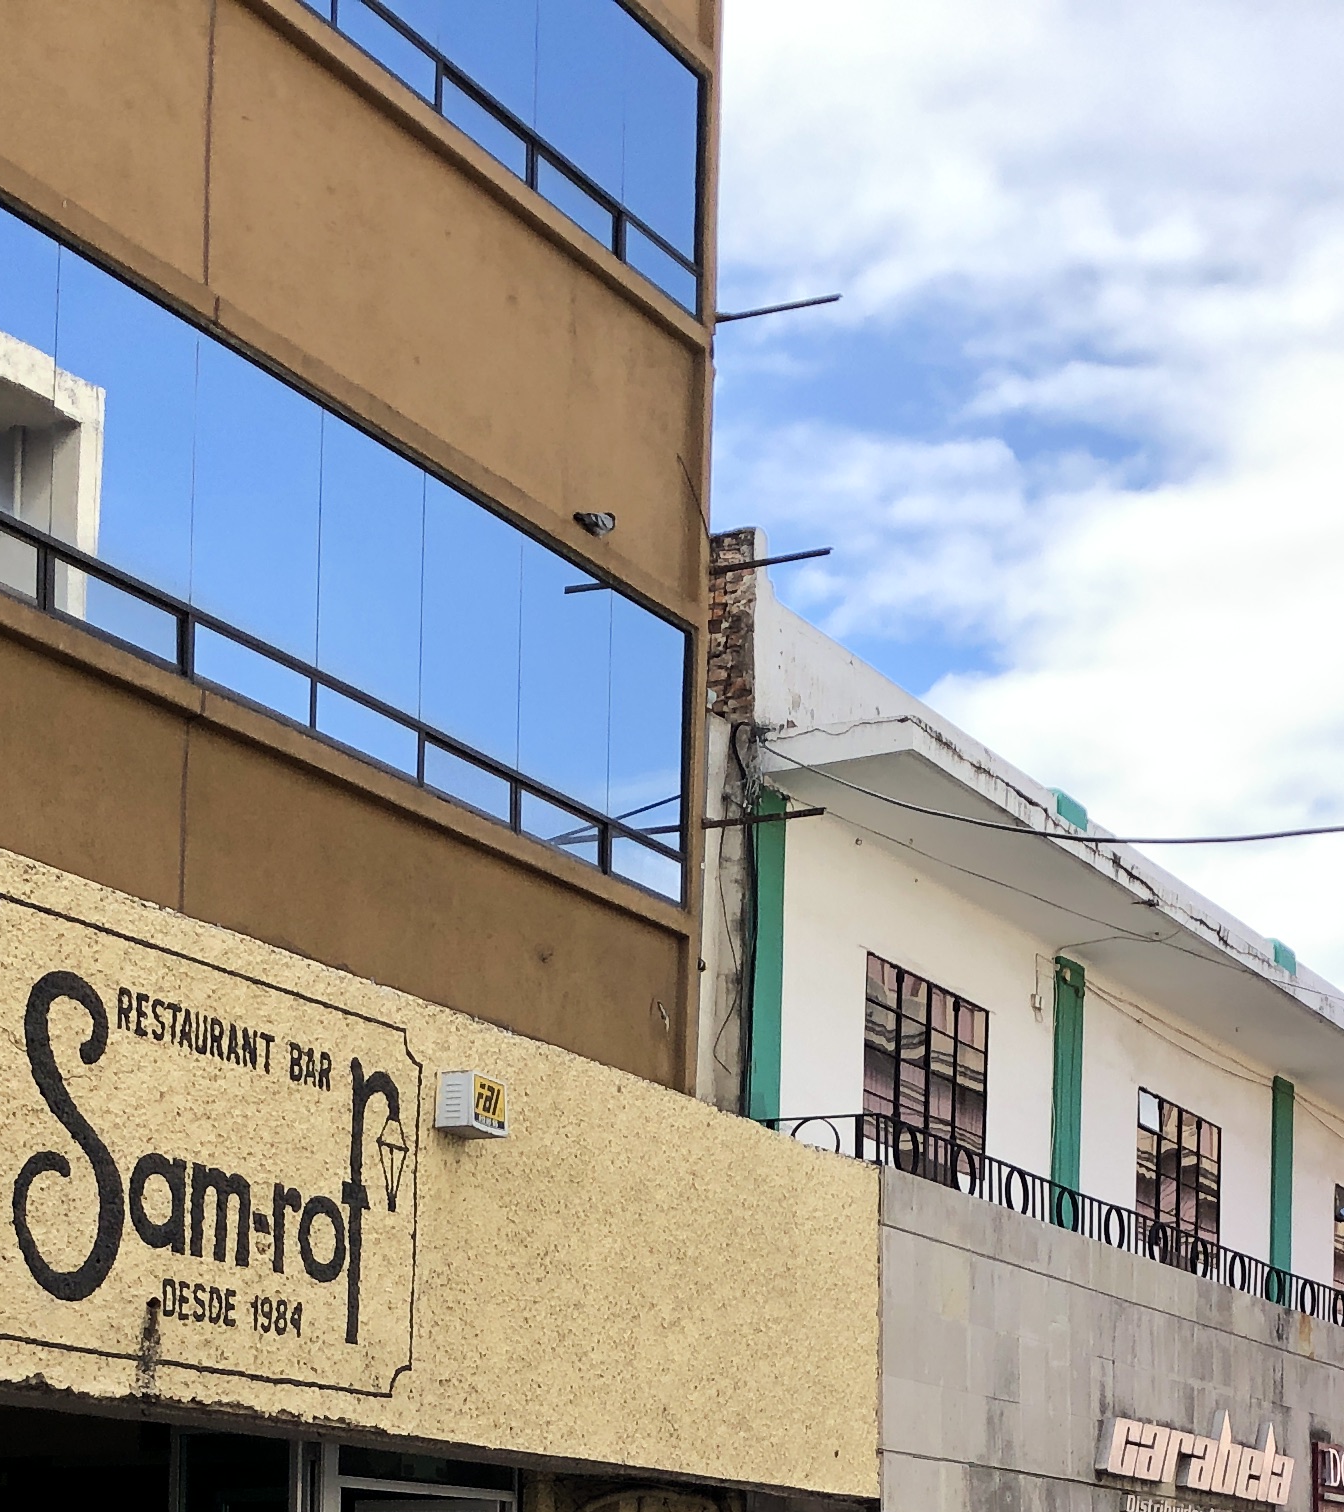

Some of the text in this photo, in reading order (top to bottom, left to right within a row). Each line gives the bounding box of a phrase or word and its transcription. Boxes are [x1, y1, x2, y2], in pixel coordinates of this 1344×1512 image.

[116, 985, 333, 1092] RESTAURANT BAR
[162, 1278, 303, 1338] DESDE 1984
[1106, 1409, 1295, 1506] carabela
